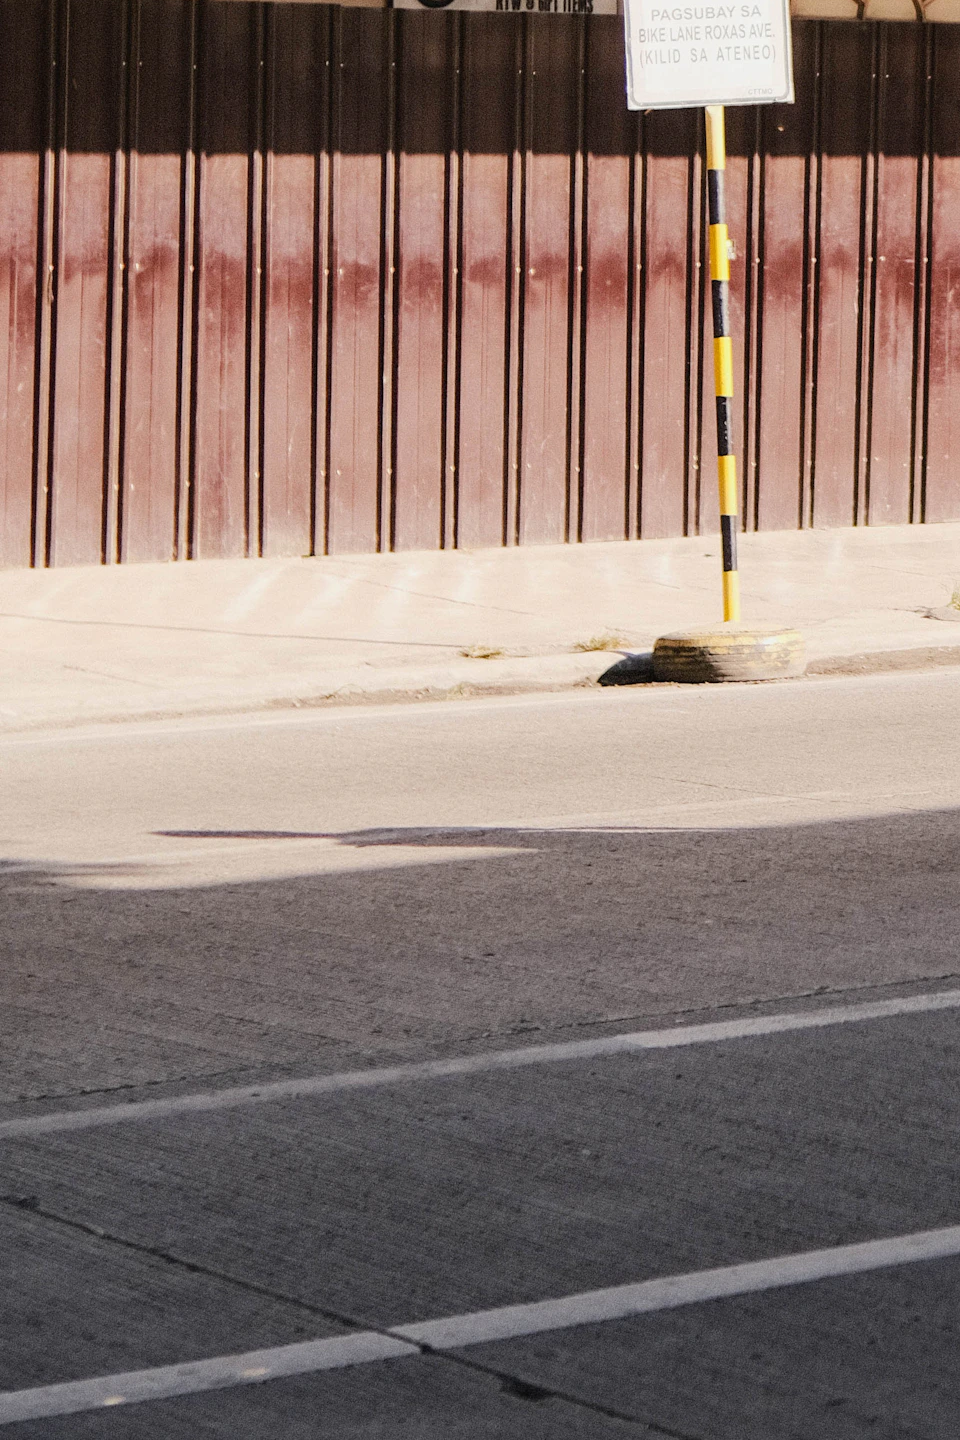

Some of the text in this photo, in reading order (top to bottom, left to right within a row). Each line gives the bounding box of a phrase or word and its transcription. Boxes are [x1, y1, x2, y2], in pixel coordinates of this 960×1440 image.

[650, 4, 762, 22] PAGSUBAY SA
[638, 23, 776, 43] BIKE LANE ROXAS AVE.
[639, 45, 776, 68] (KILID SA ATENEO)
